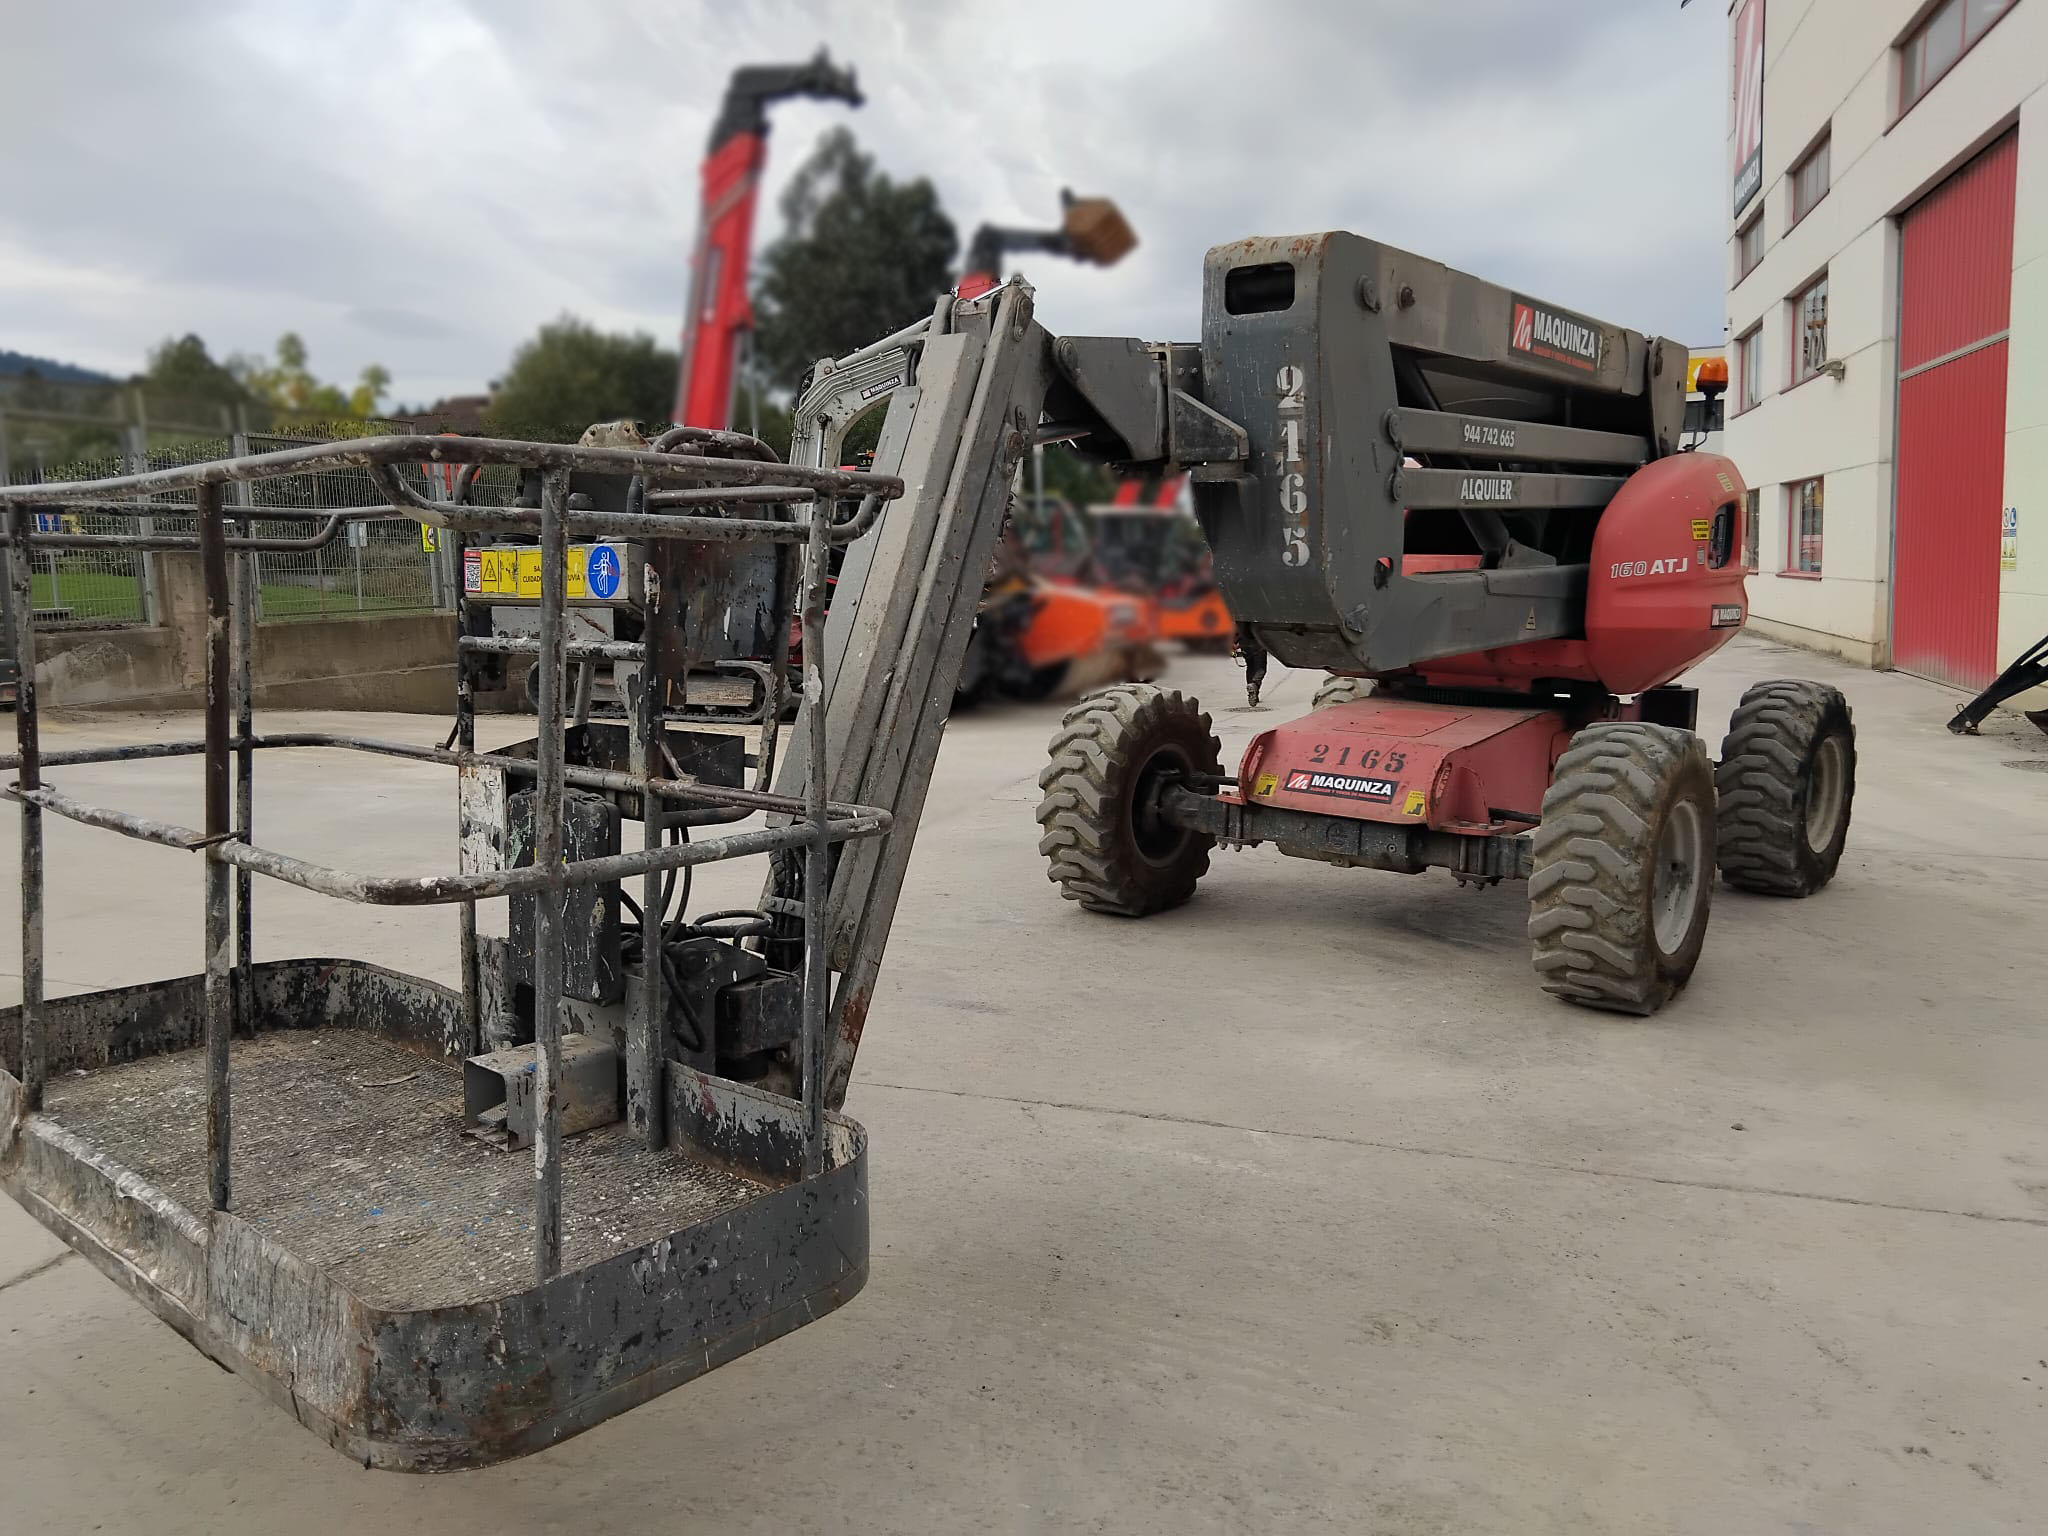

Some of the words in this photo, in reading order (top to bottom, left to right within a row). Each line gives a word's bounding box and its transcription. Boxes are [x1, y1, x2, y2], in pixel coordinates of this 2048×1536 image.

[1533, 310, 1595, 359] MAQUINZA
[1464, 424, 1481, 444] 944
[1482, 427, 1499, 446] 742
[1500, 429, 1515, 448] 665
[1460, 478, 1513, 501] ALQUILER
[1611, 561, 1647, 579] 160
[1649, 557, 1689, 575] ATJ
[1309, 744, 1406, 773] 2165
[1311, 774, 1392, 796] MAQUINZA
